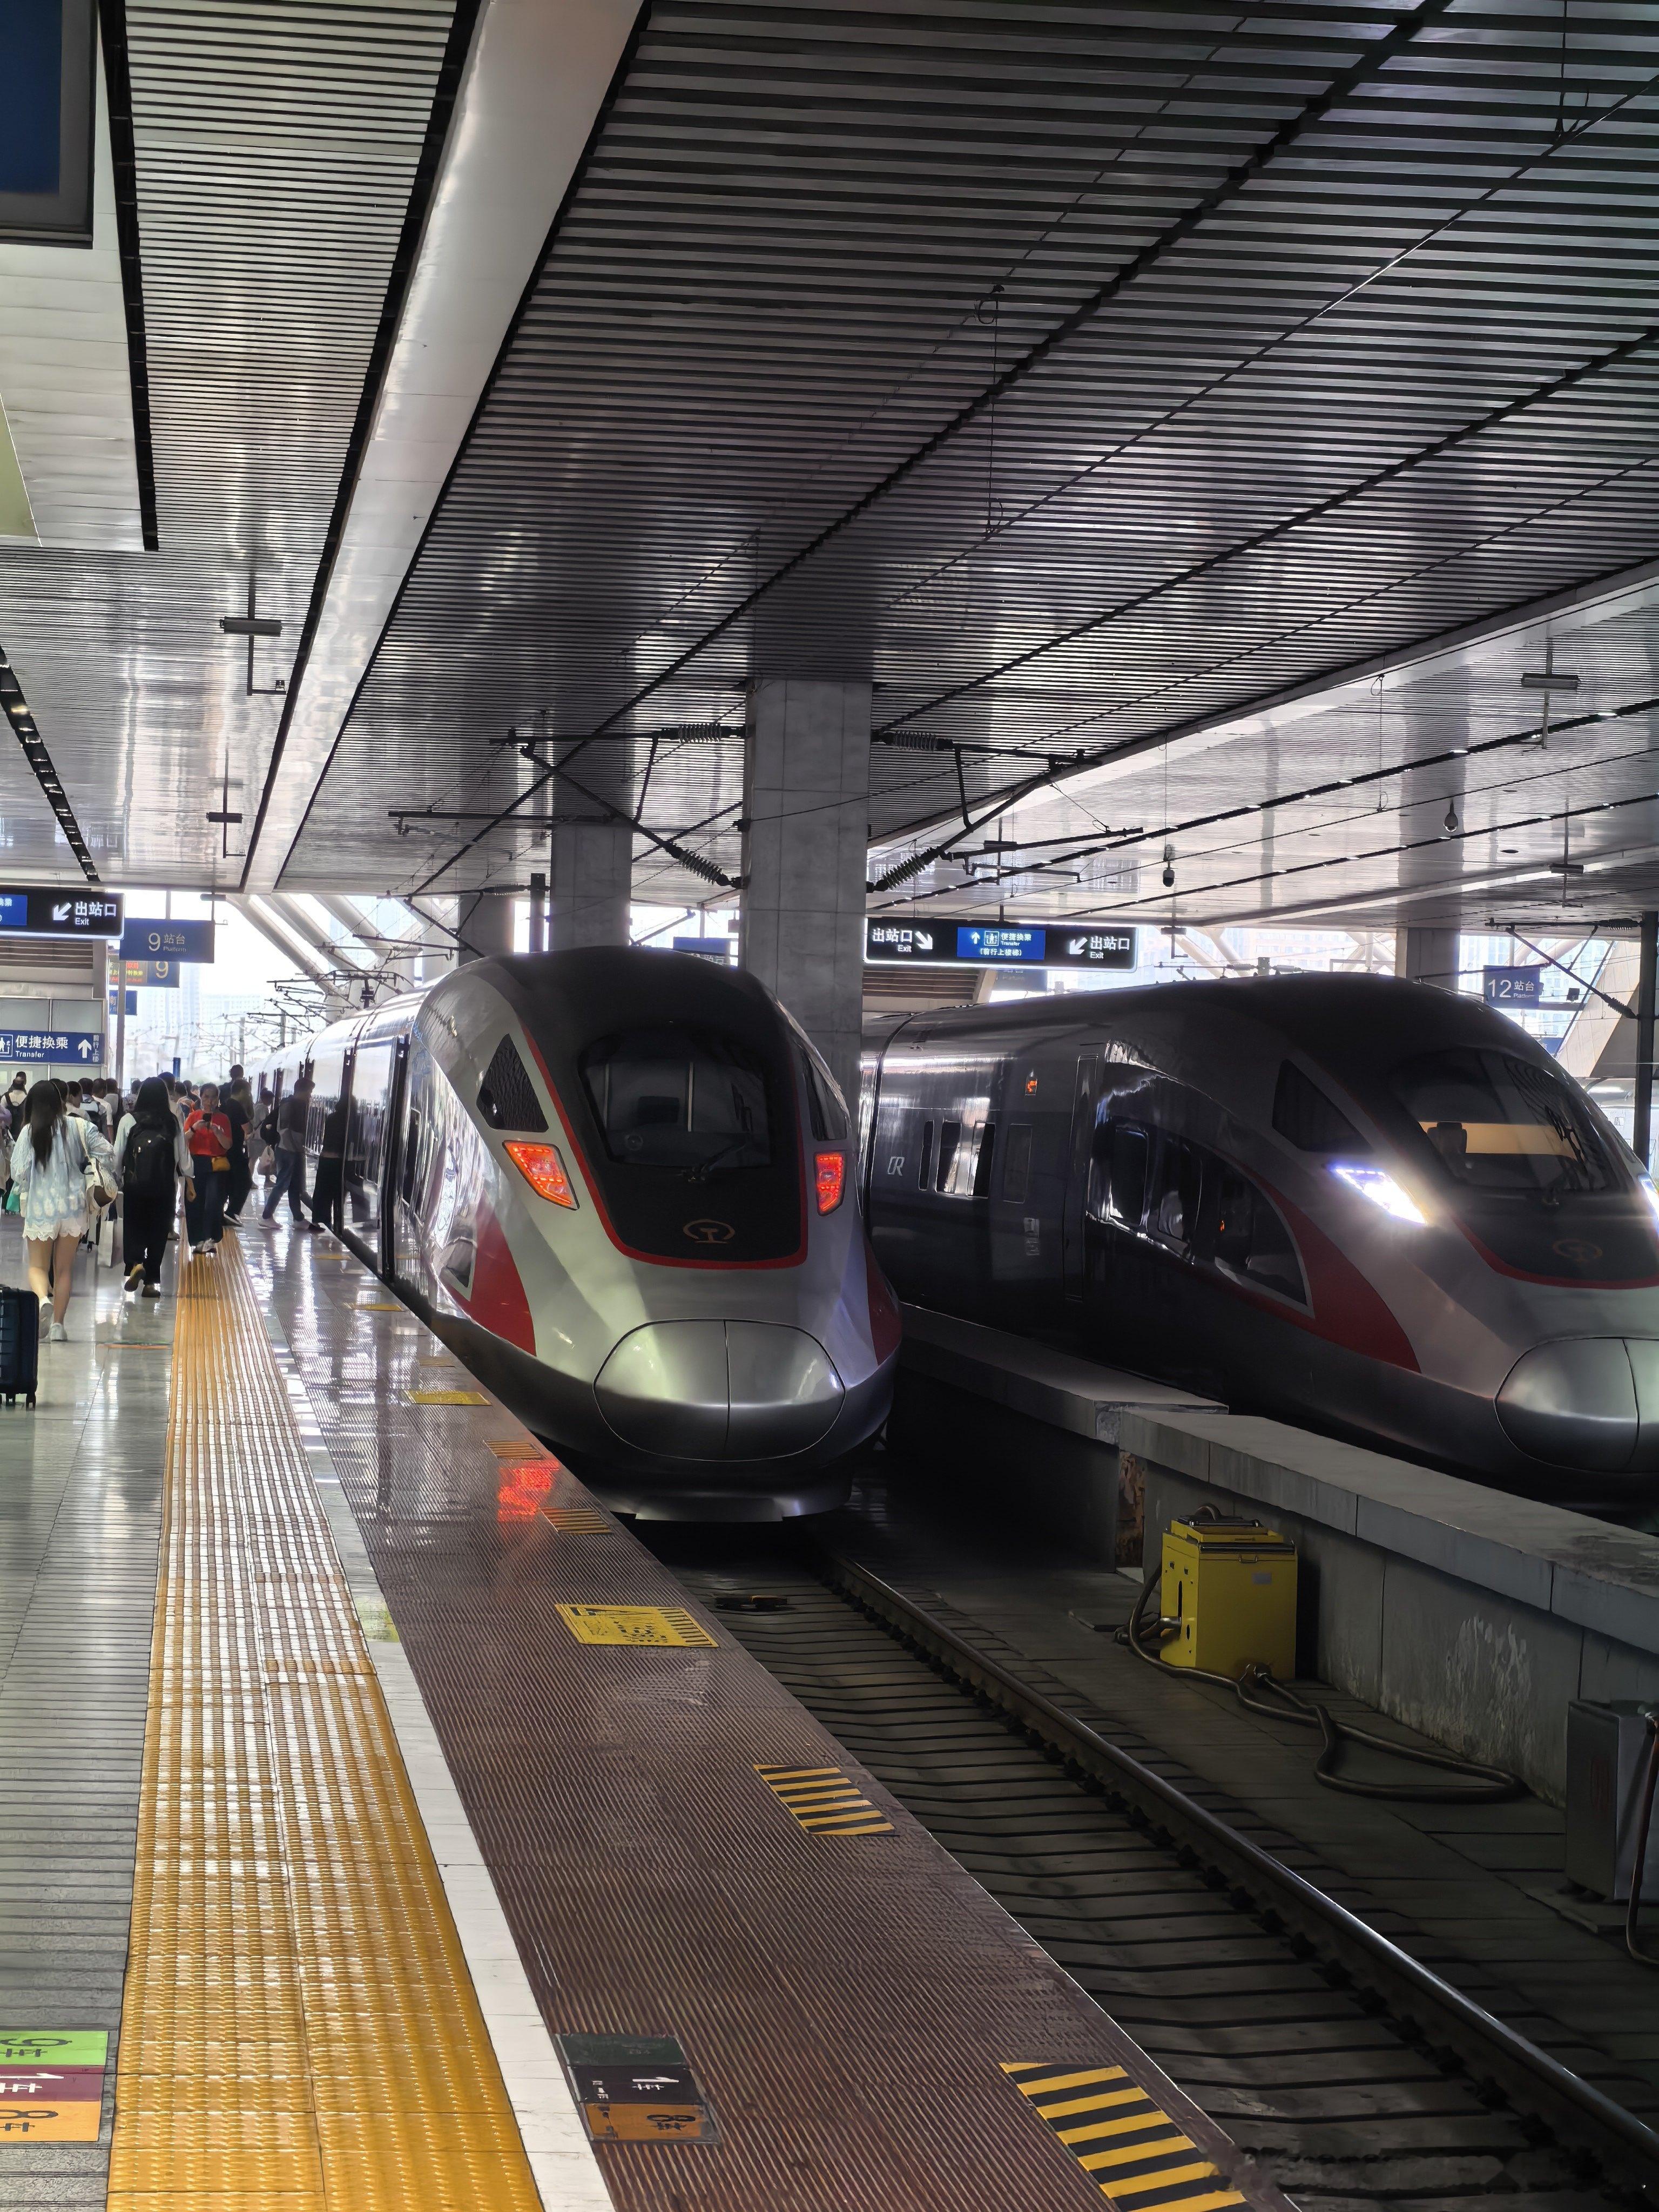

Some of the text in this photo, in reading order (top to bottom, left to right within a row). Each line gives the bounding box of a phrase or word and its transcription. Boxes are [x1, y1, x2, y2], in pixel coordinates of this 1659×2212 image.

[75, 901, 116, 916] 出站口
[149, 933, 185, 951] 9 站台
[872, 928, 913, 942] 出站口
[1001, 933, 1032, 941] 便捷换乘
[1090, 936, 1130, 950] 出站口
[156, 961, 168, 979] 9
[1488, 980, 1534, 997] 12 站台
[16, 1035, 68, 1049] 便捷换乘
